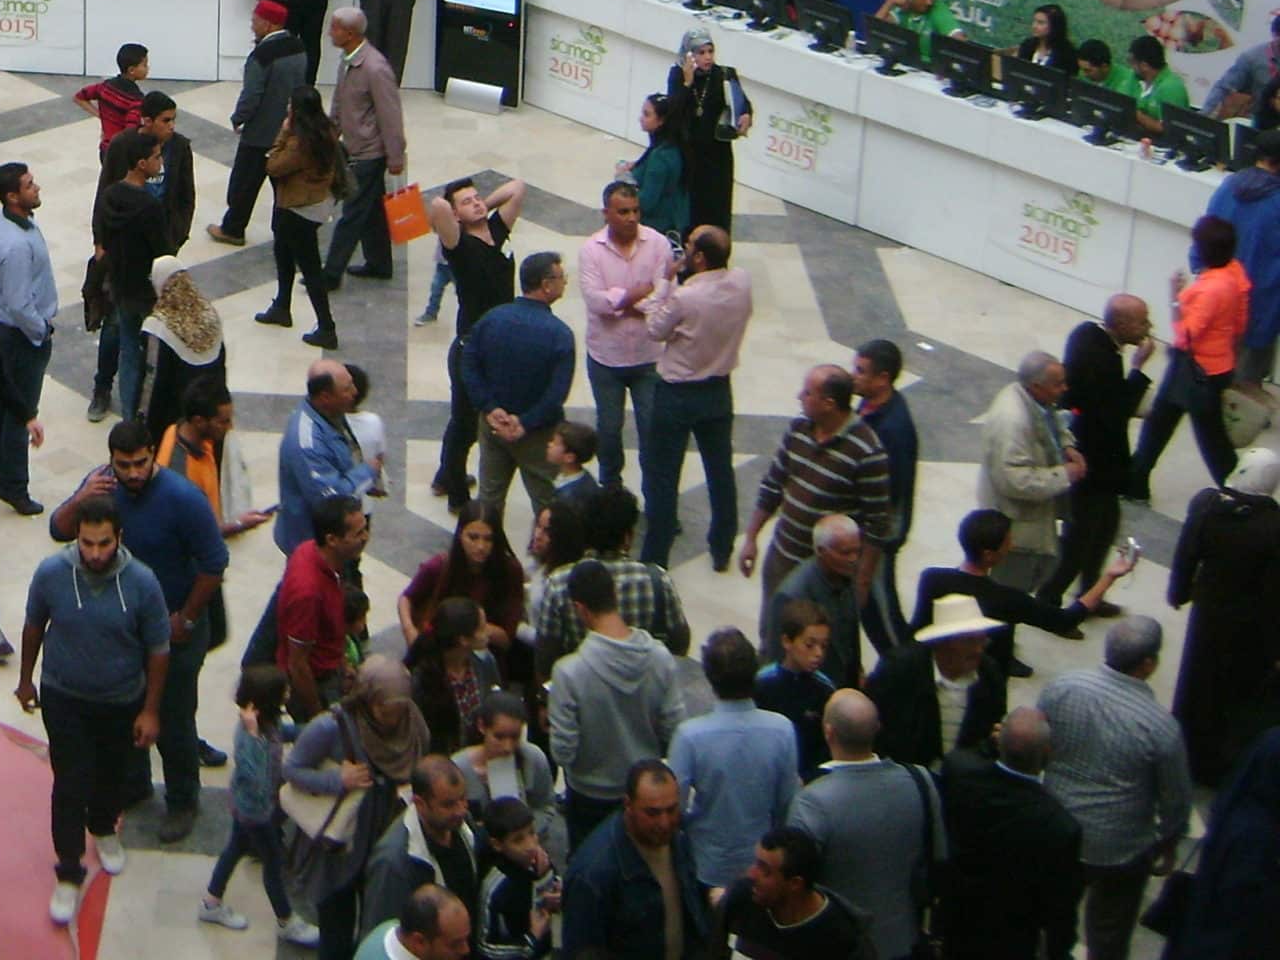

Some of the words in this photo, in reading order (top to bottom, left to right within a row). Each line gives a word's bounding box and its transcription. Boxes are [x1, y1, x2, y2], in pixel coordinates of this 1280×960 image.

[549, 33, 603, 66] siamap
[548, 56, 593, 89] 2015
[765, 134, 817, 172] 2015
[1019, 224, 1076, 265] 2015
